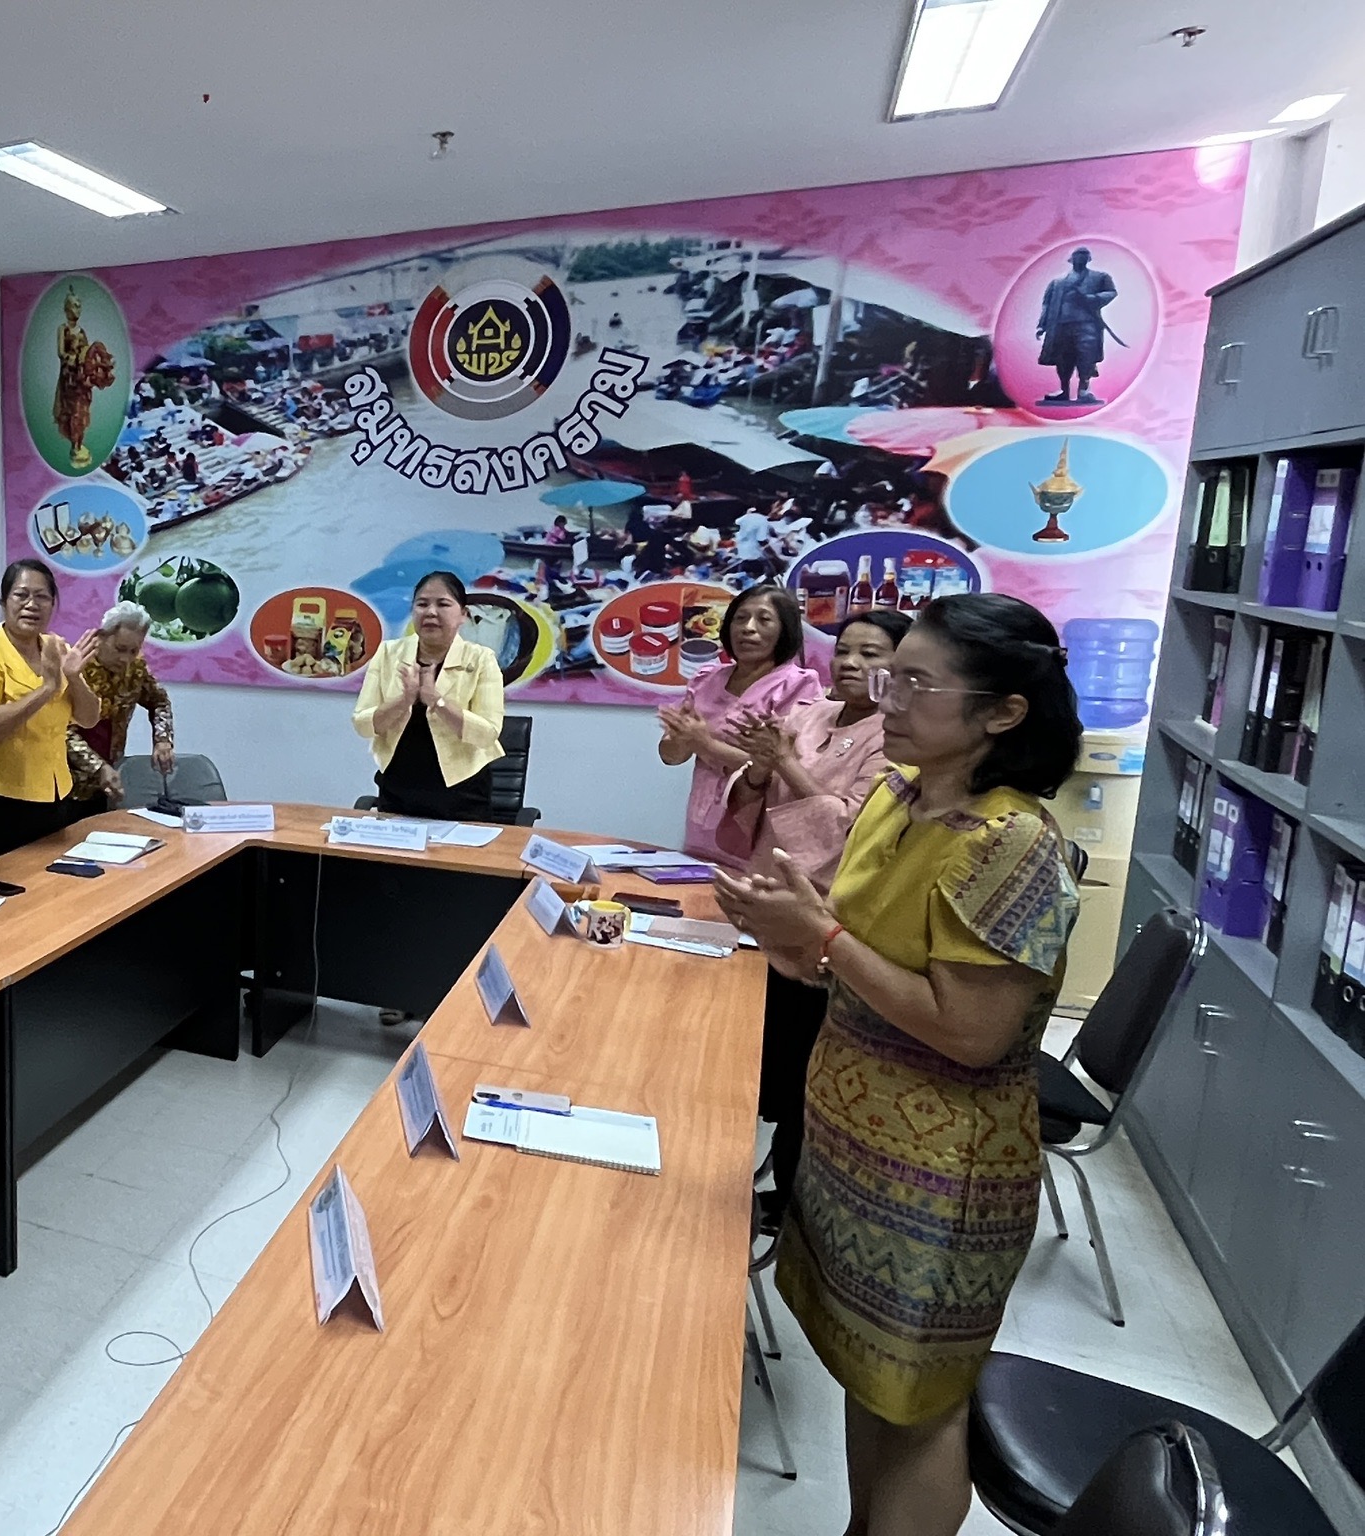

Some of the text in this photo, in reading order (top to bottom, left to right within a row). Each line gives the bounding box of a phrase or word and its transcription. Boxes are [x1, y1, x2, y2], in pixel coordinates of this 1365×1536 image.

[343, 346, 651, 495] สมุทรสงคราม
